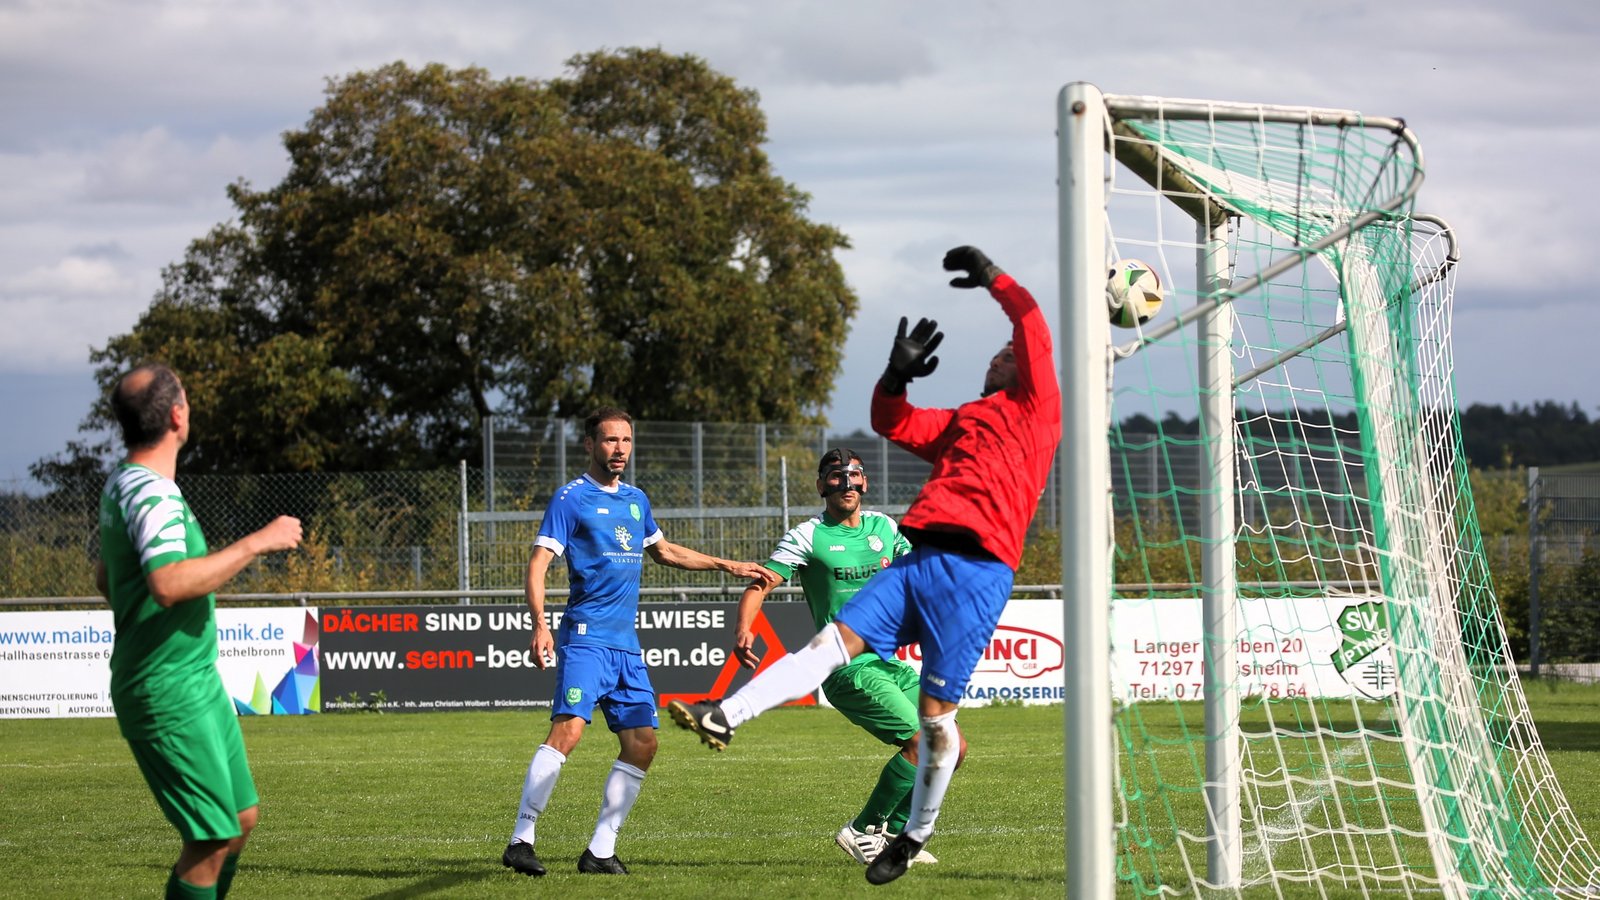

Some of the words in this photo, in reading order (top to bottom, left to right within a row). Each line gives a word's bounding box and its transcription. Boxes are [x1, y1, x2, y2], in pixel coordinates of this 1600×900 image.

[834, 564, 878, 580] ERLUS
[323, 609, 420, 633] DÄCHER
[425, 612, 482, 632] SIND
[488, 611, 565, 631] UNSER
[634, 610, 725, 629] ELWIESE
[1346, 611, 1379, 630] SV
[216, 646, 285, 658] schelbronn
[984, 638, 1037, 660] INCI
[1134, 639, 1200, 657] Langer
[1236, 638, 1275, 653] ben
[1281, 637, 1303, 653] 20
[1139, 661, 1194, 675] 71297
[0, 692, 99, 702] NENSCHUTZFOLIERUNG
[1130, 683, 1168, 698] Tel.:
[1175, 683, 1185, 698] 0
[1192, 683, 1202, 698] 7
[1286, 682, 1307, 698] 64
[68, 705, 114, 714] AUTOFOLIE
